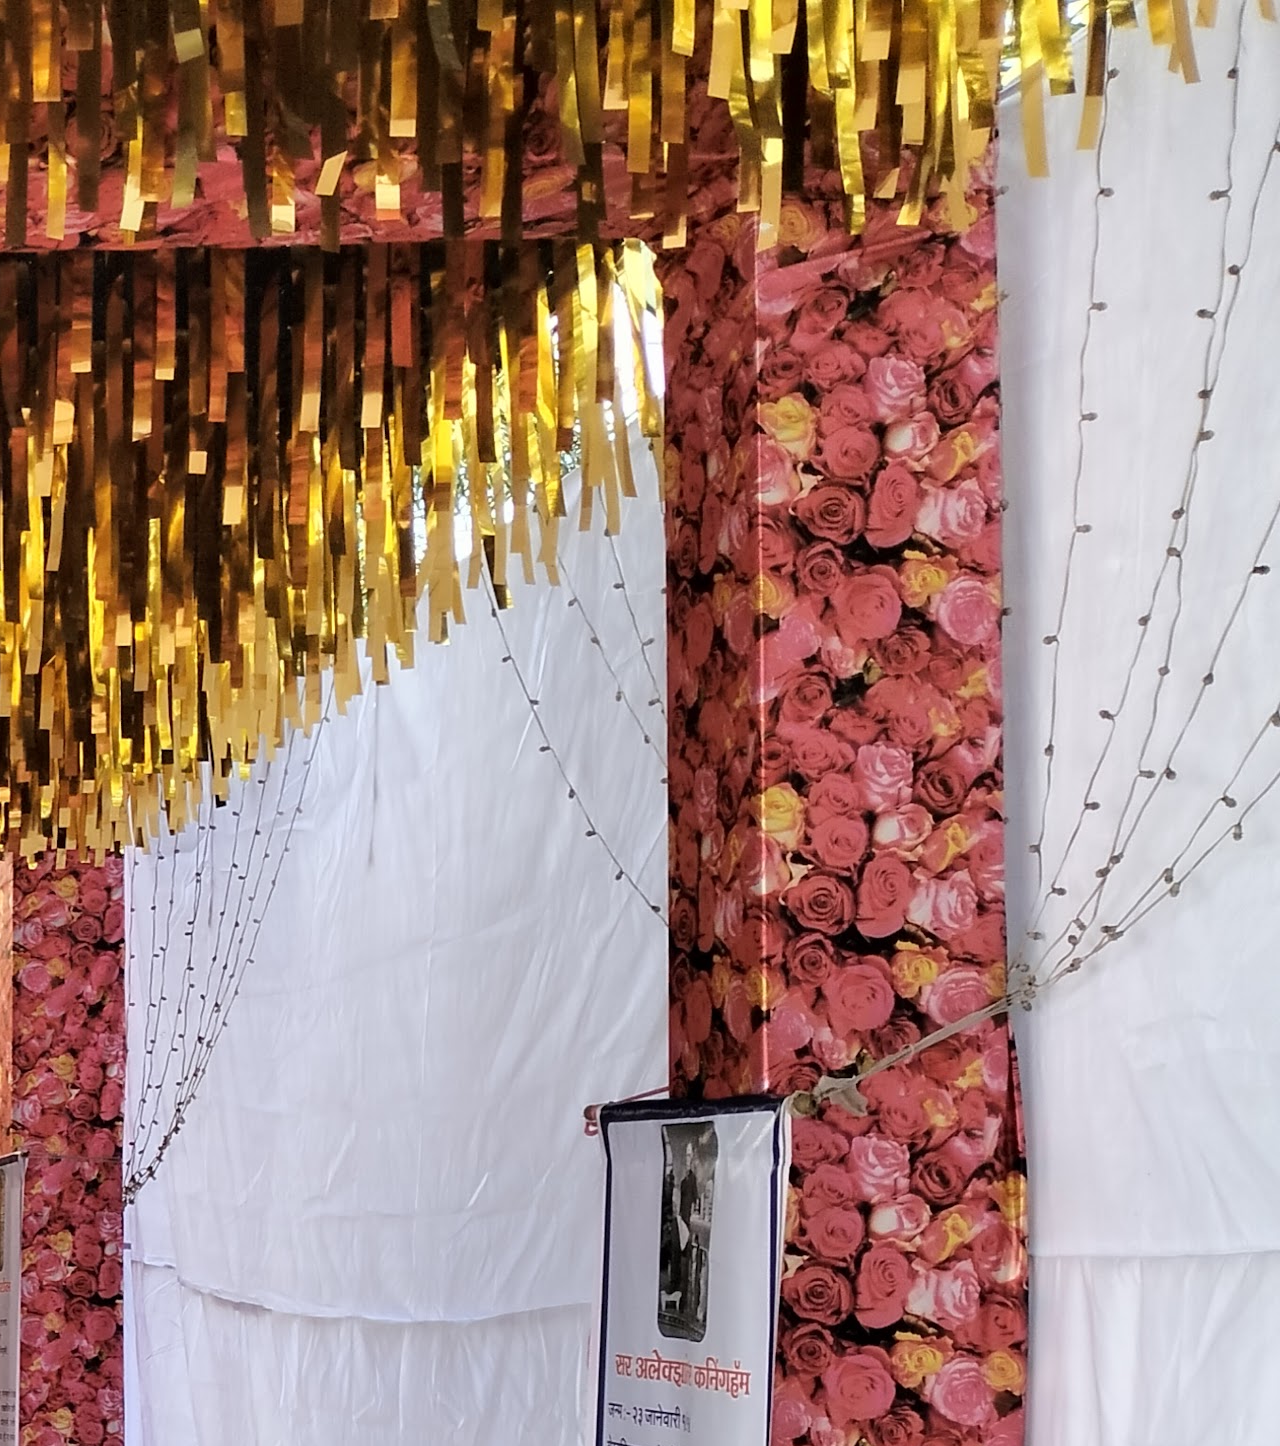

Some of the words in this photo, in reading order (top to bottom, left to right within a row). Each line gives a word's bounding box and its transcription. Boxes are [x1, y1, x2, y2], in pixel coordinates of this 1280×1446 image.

[615, 1353, 633, 1377] सर
[694, 1356, 751, 1398] कनिंगहॅम
[645, 1404, 680, 1429] जानेवारी
